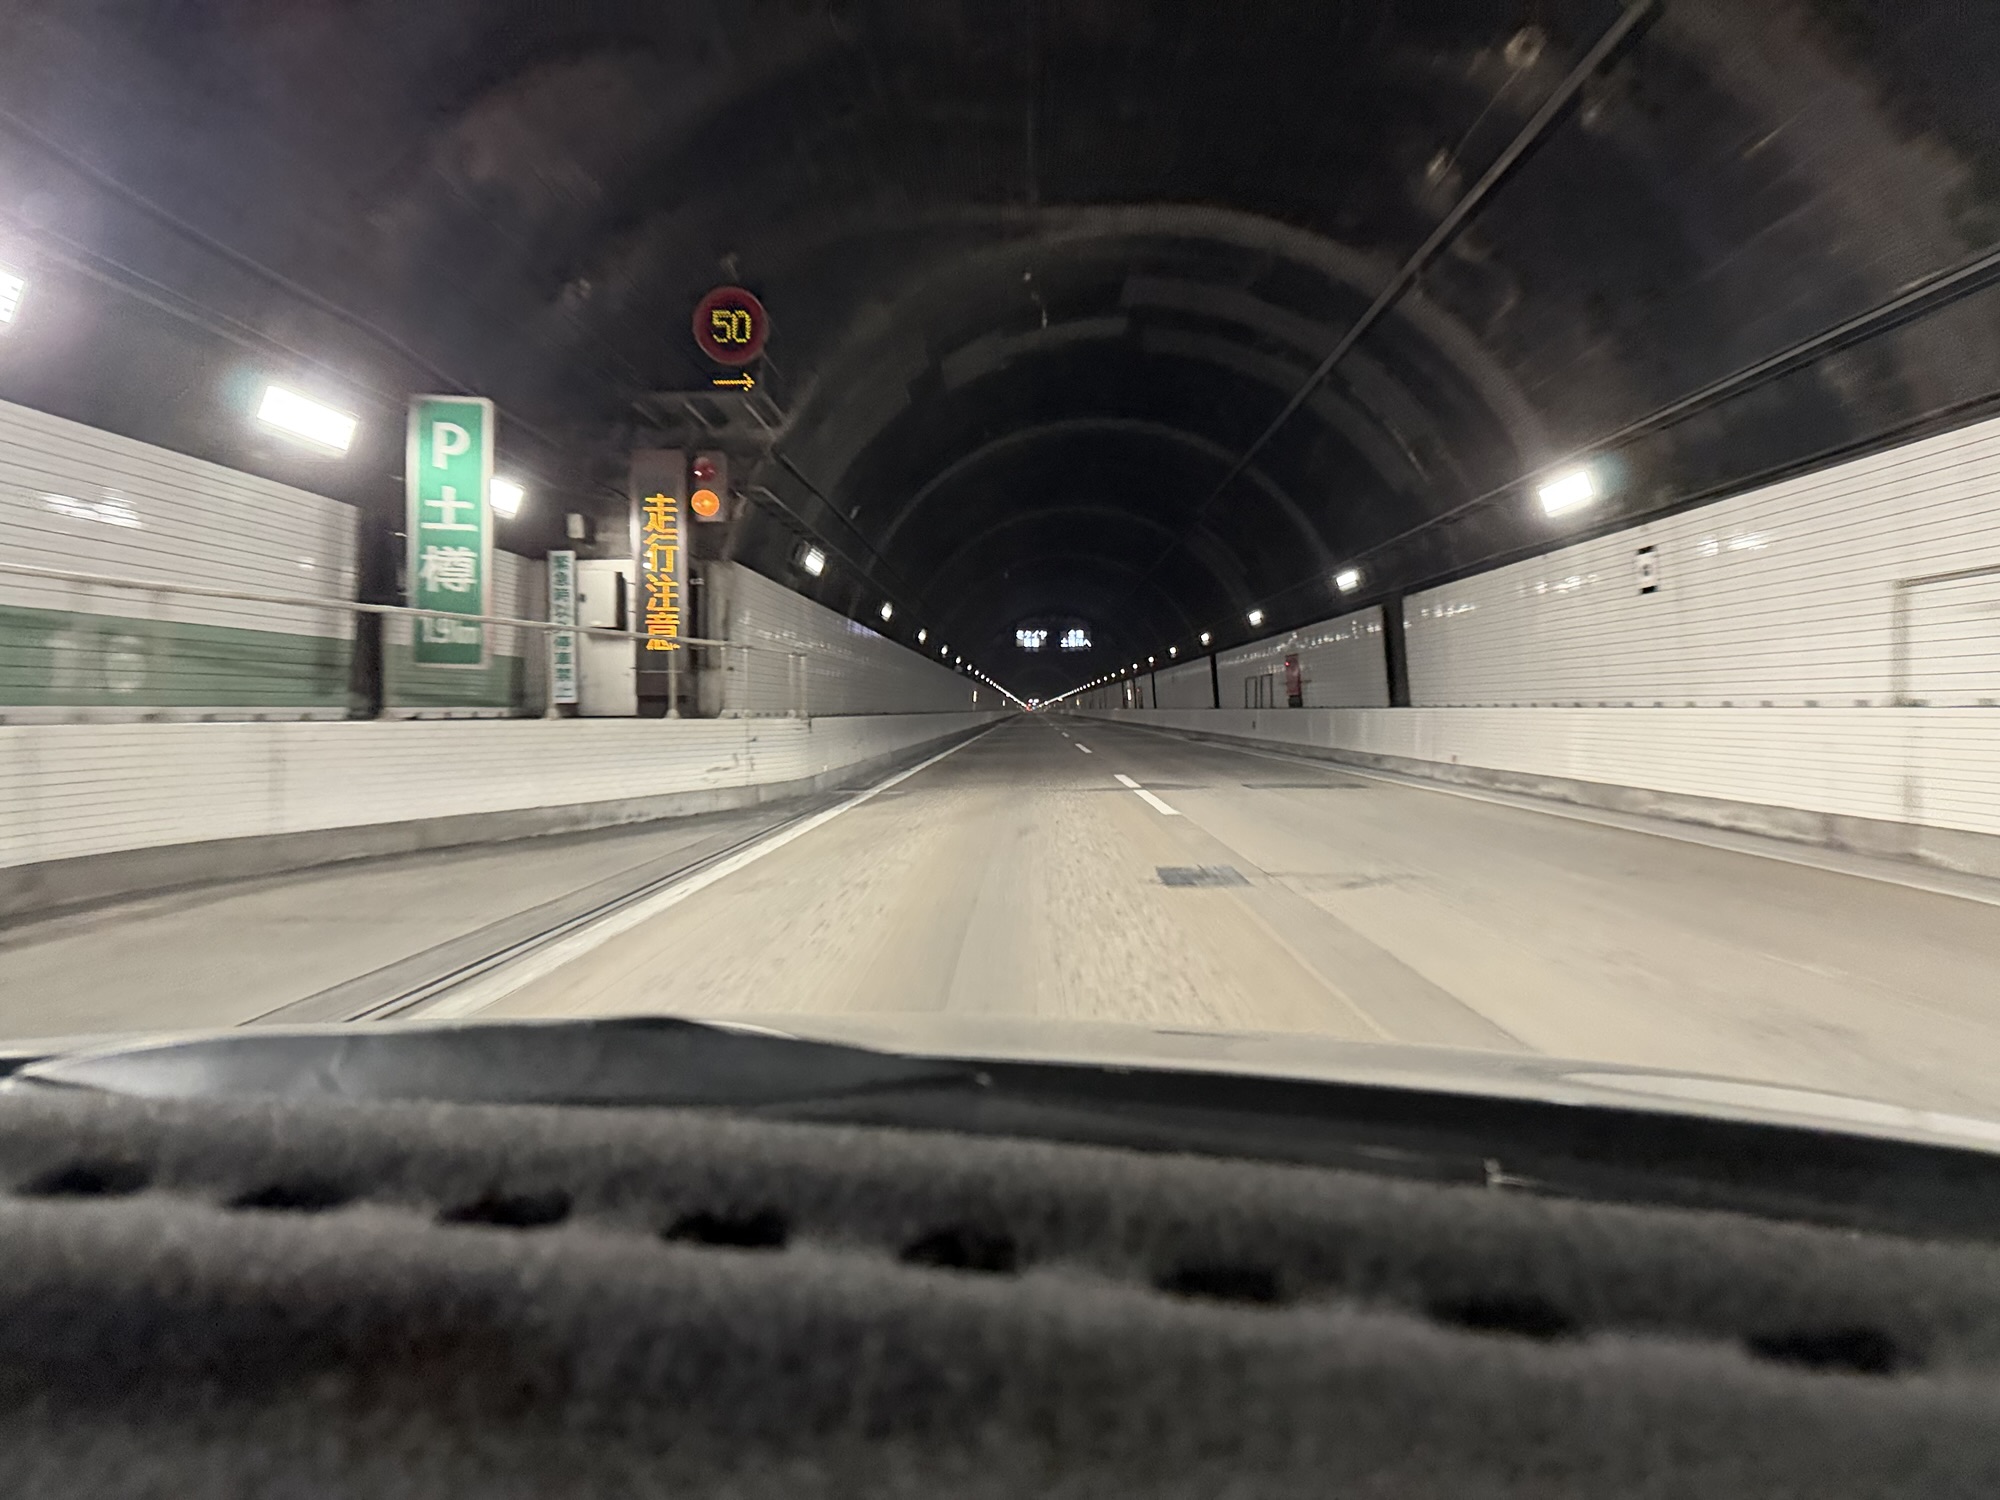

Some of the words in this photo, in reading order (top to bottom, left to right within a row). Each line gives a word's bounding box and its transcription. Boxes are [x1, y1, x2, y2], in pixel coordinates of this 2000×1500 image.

[711, 309, 753, 344] 50
[642, 493, 681, 651] 走行注意
